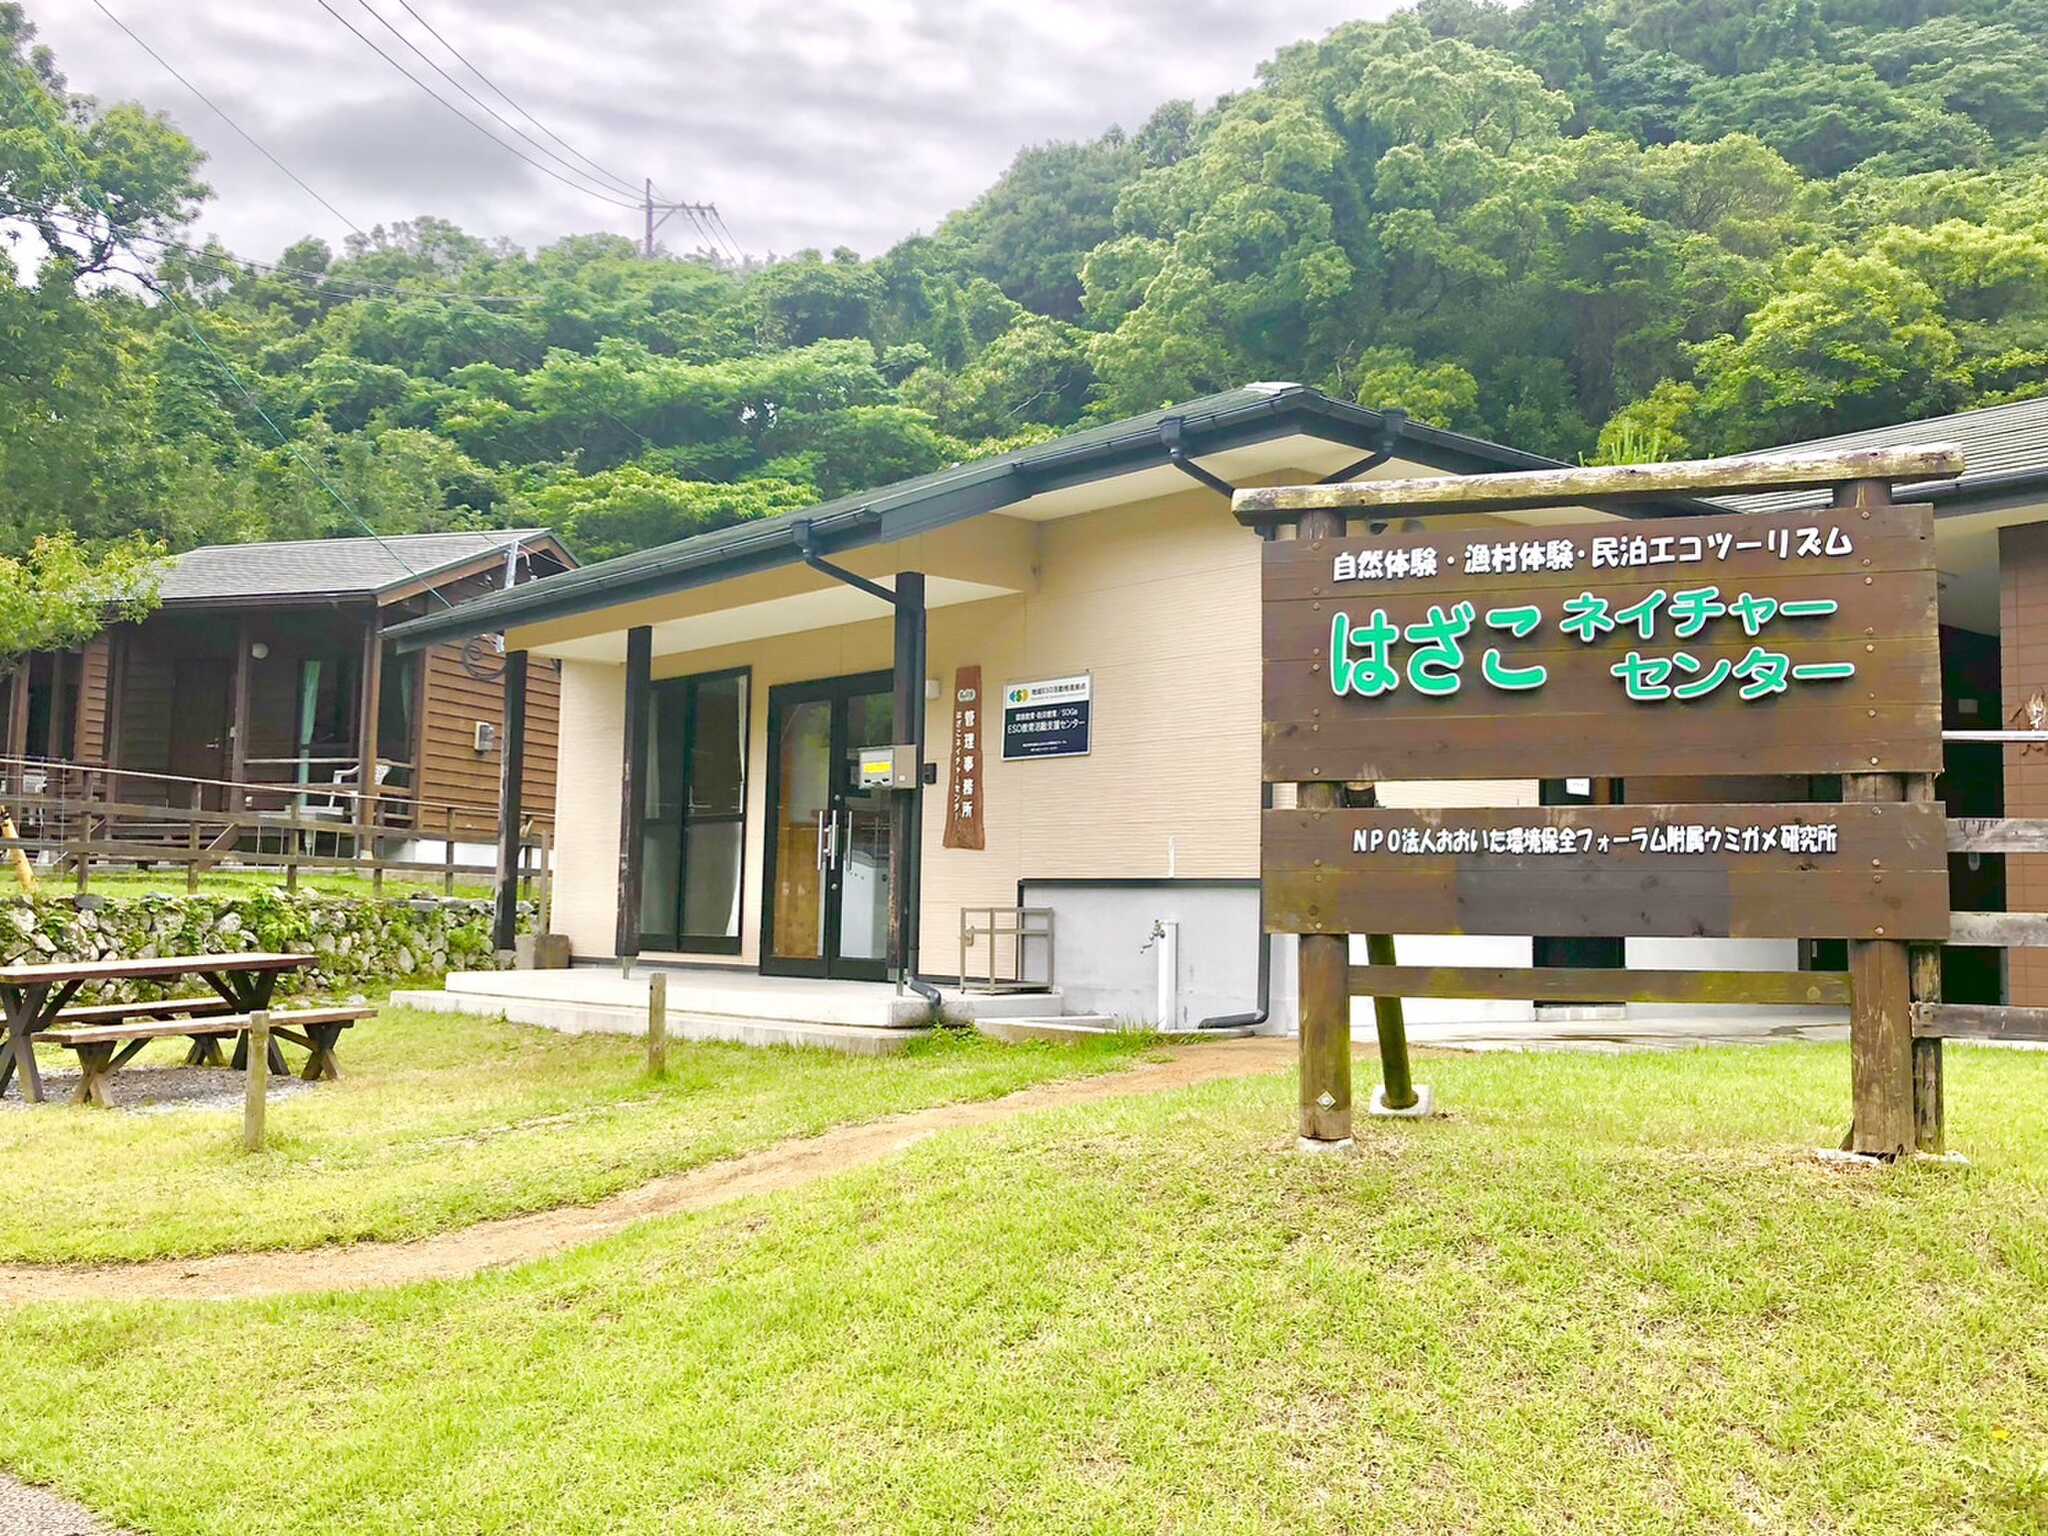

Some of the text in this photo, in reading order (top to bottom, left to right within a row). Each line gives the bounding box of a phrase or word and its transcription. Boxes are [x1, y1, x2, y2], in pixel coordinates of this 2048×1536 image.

[1329, 586, 1838, 698] はざこ ネイチャー
[1611, 646, 1856, 700] センター
[962, 709, 975, 818] 管理事務所
